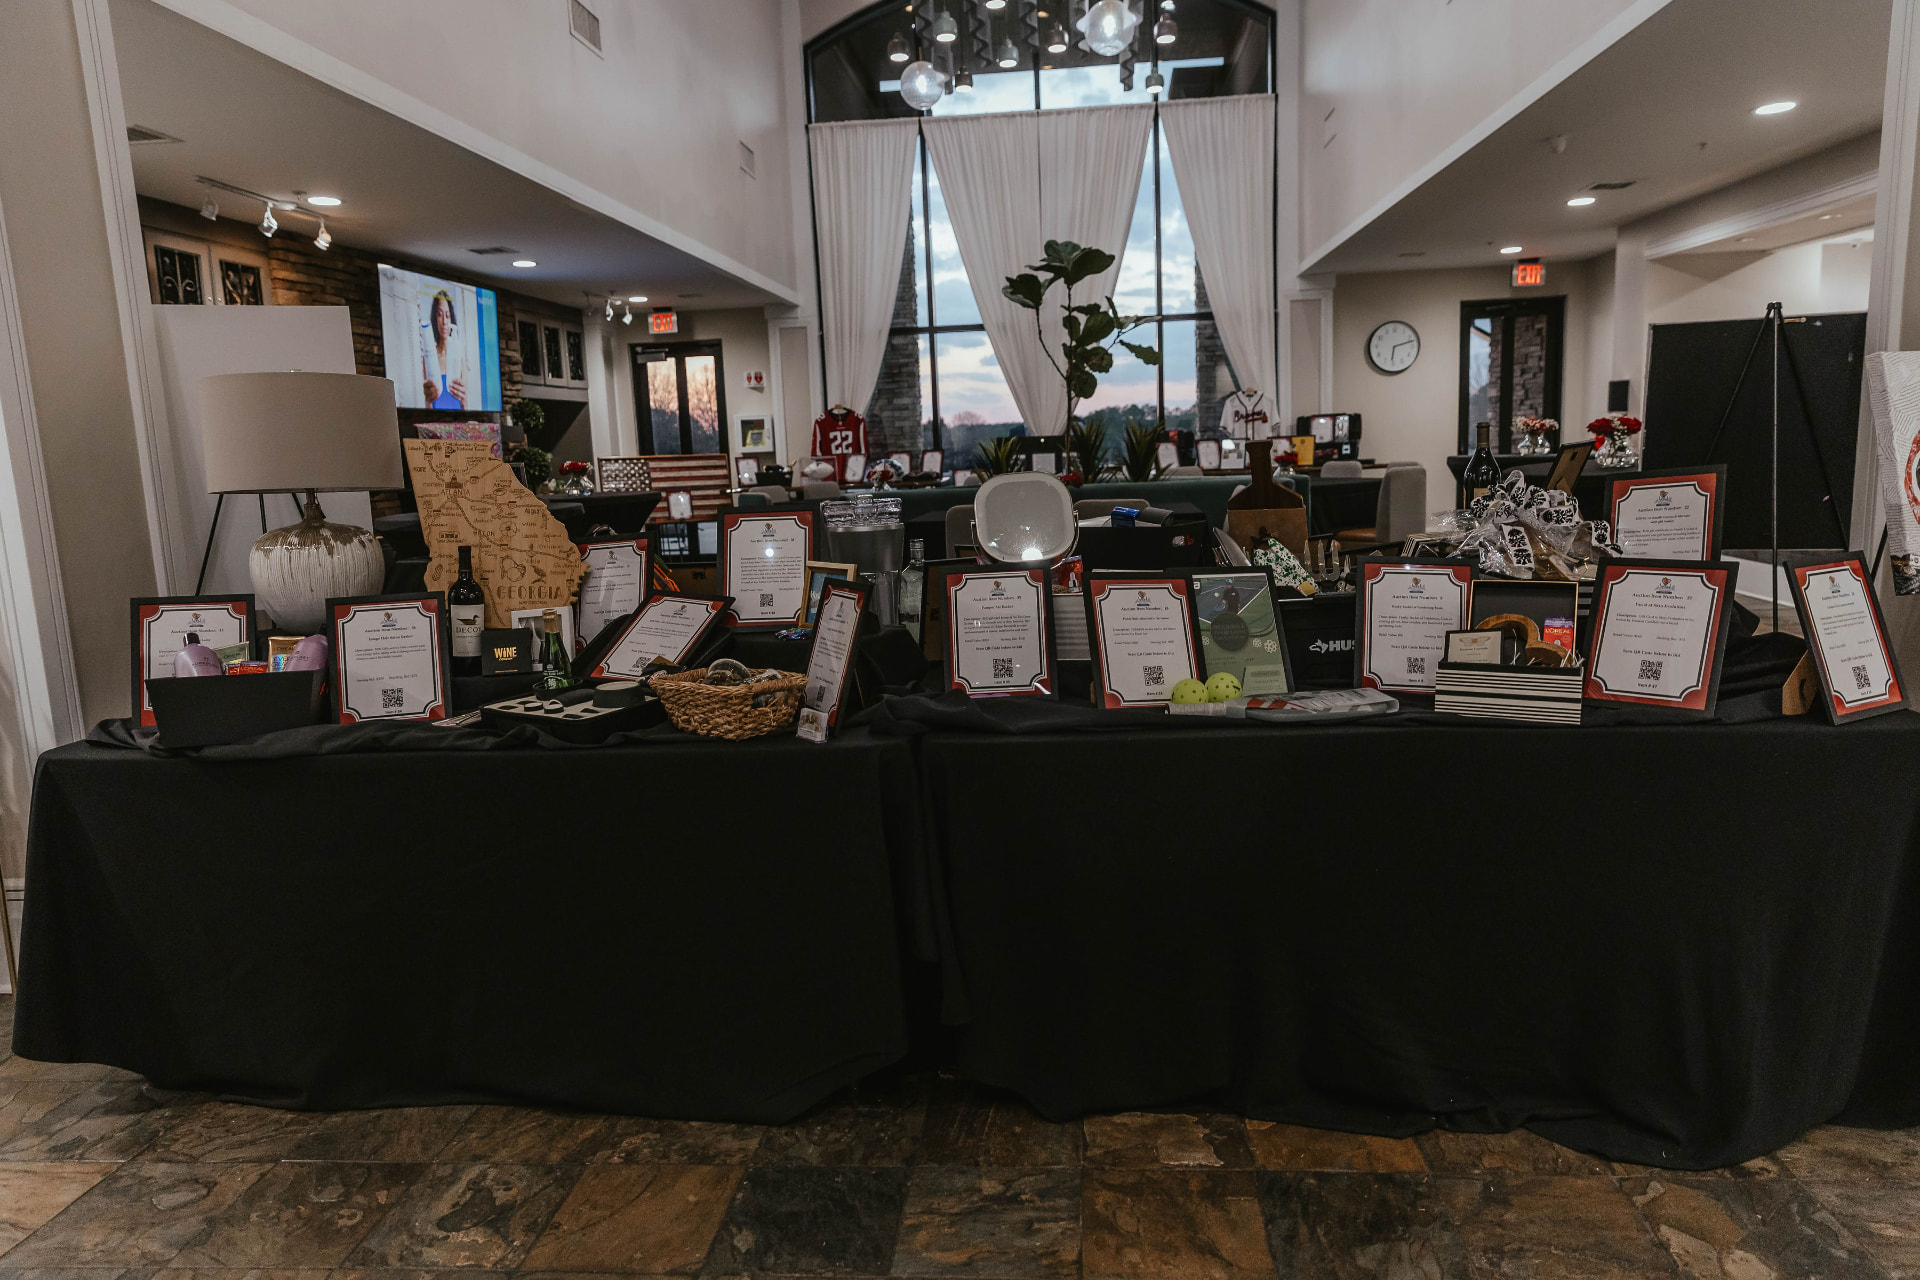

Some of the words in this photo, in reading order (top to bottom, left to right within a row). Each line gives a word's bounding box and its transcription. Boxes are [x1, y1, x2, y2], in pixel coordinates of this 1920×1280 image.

[1517, 264, 1543, 284] EXIT
[653, 313, 673, 332] EXIT
[829, 431, 852, 454] 22
[497, 586, 564, 600] GEORGIA
[494, 646, 517, 658] WINE
[1329, 640, 1355, 651] HU
